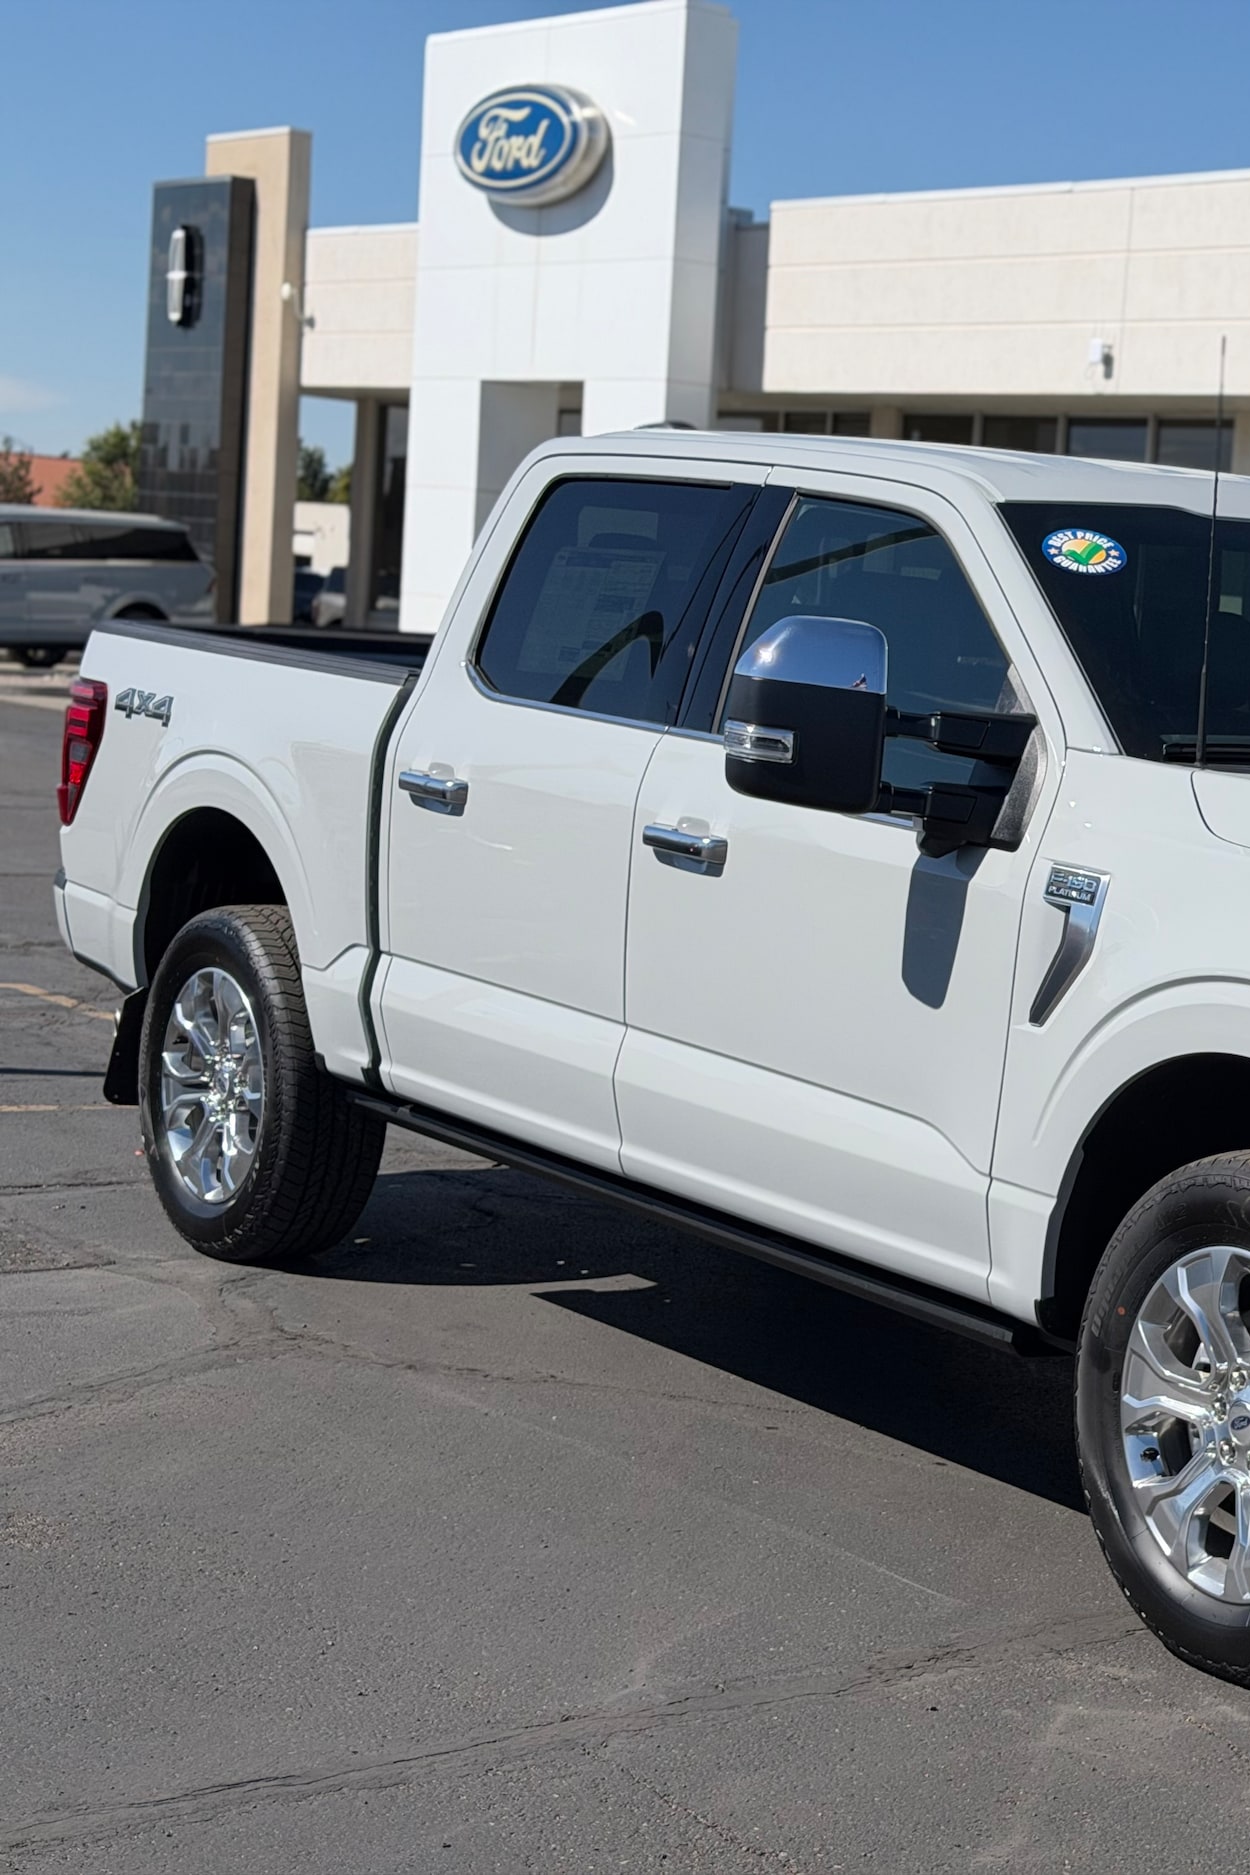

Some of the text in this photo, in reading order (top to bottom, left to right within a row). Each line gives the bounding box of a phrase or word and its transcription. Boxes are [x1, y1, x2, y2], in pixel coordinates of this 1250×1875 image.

[471, 107, 550, 174] Ford
[1047, 531, 1115, 549] BEST PRICE
[1052, 555, 1122, 574] GUARANTEE
[1047, 885, 1092, 901] PLATIUM
